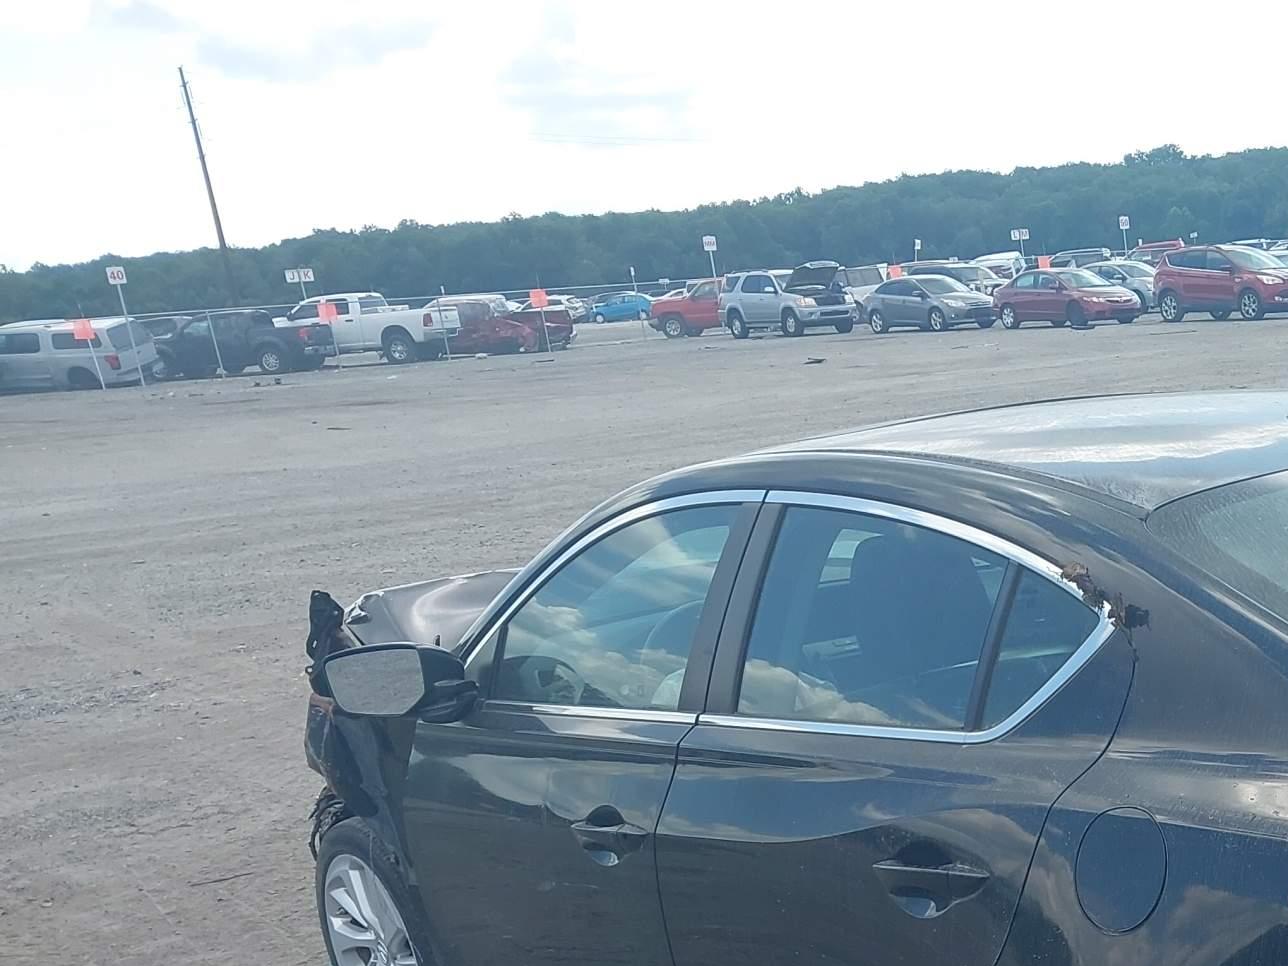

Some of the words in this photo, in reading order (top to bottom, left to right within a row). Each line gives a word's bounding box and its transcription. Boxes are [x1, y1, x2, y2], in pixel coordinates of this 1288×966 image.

[109, 270, 124, 281] 40
[289, 270, 296, 281] J
[303, 269, 312, 280] K
